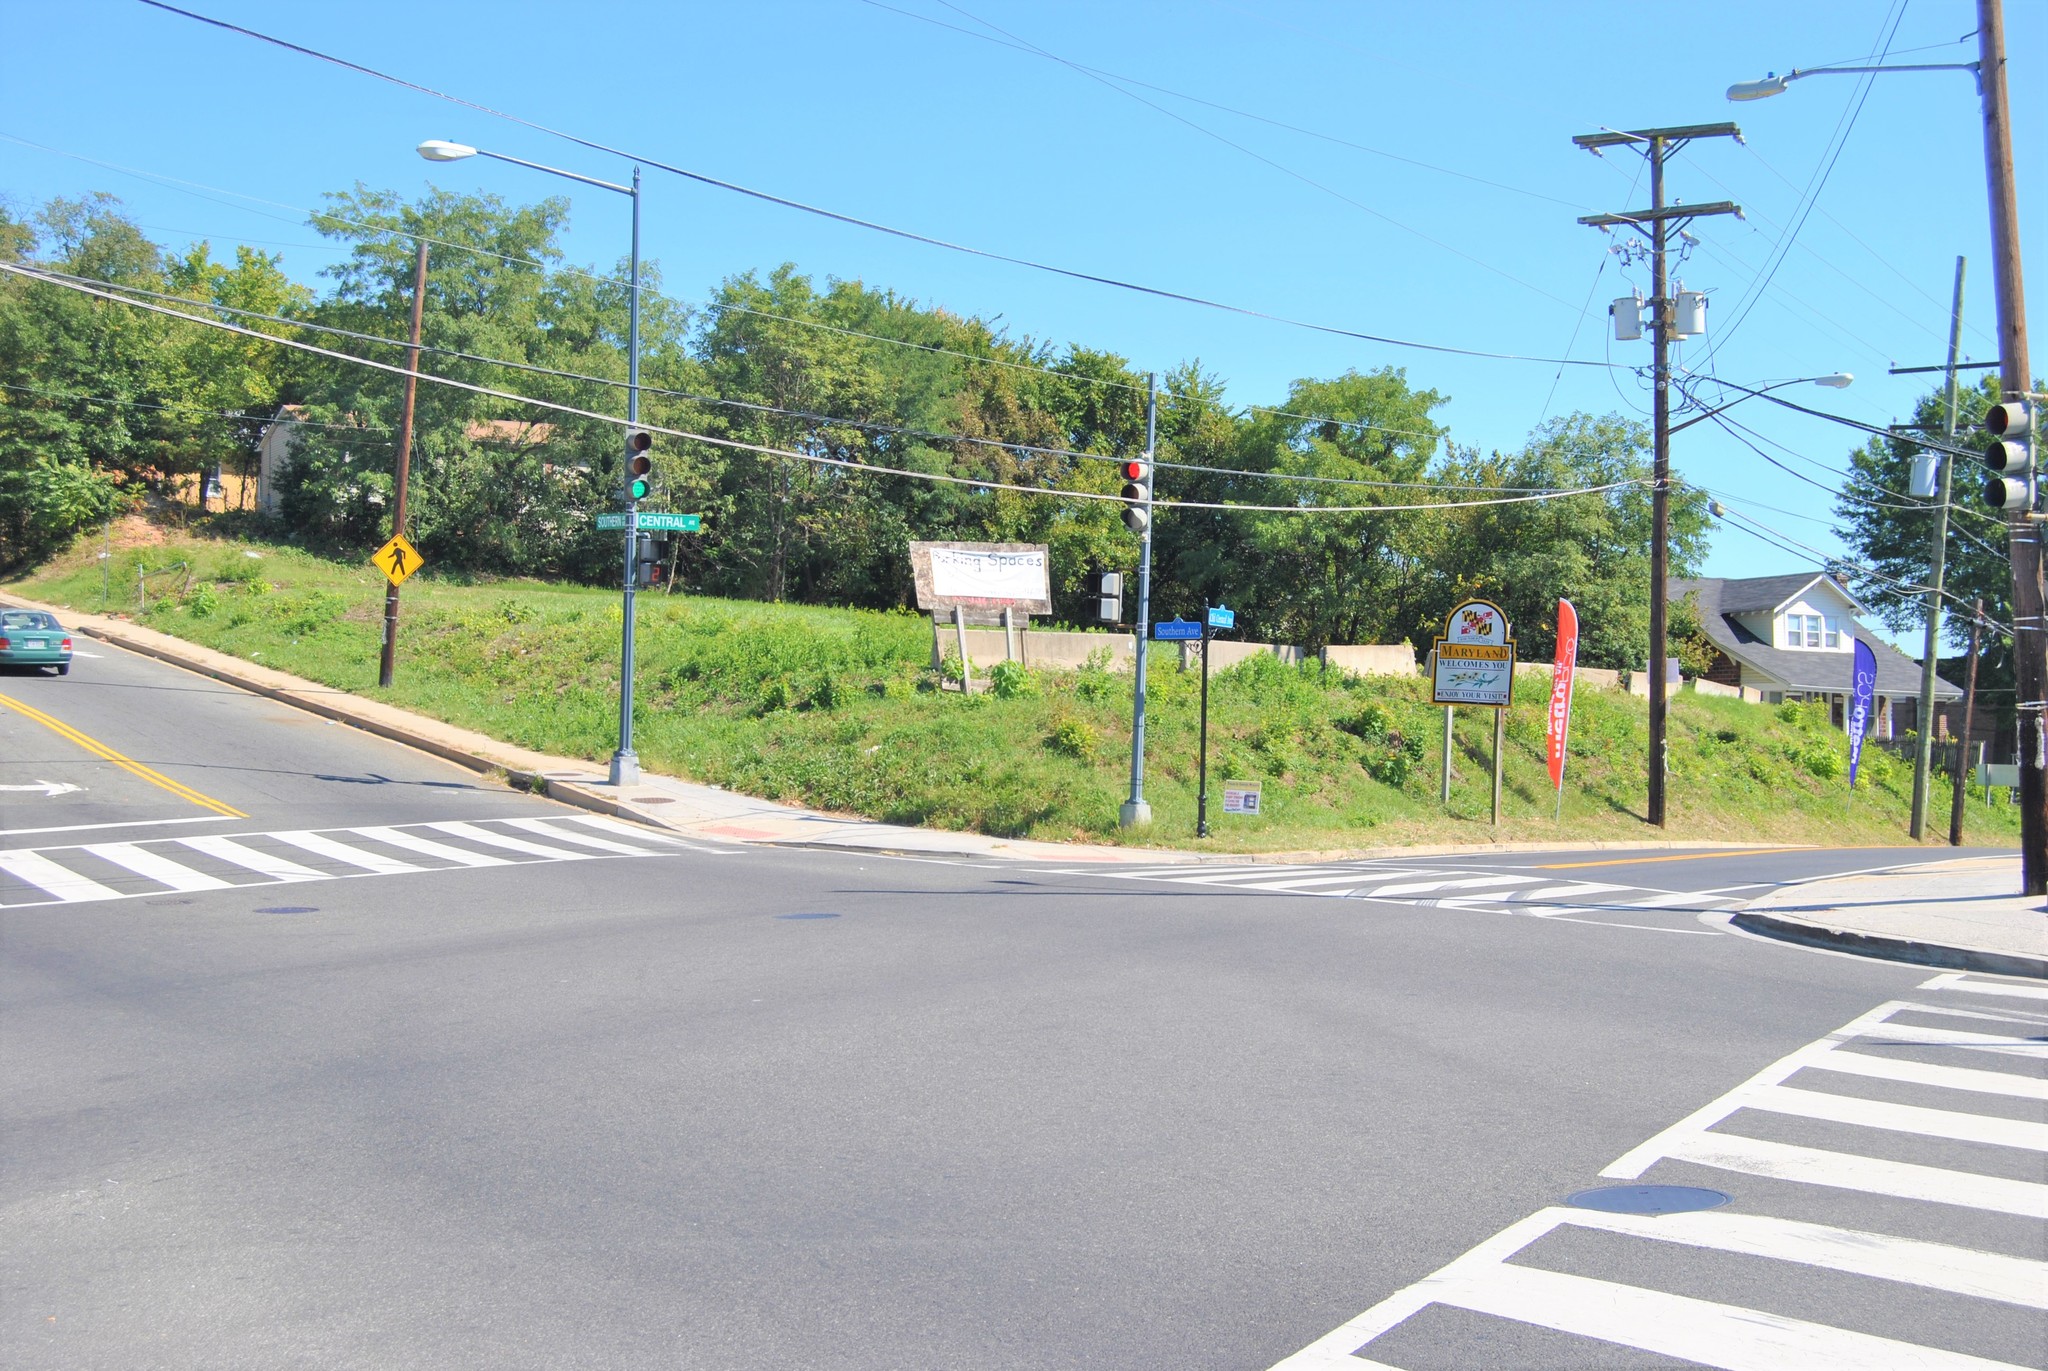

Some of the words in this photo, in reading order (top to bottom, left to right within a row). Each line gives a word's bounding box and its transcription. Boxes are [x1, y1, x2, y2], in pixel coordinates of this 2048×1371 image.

[597, 516, 622, 528] SOUTHERN
[639, 515, 686, 528] CENTRAL
[988, 553, 1042, 573] Spaces
[652, 567, 660, 582] 2
[1157, 626, 1185, 636] Southern
[1187, 627, 1199, 636] Ave
[1441, 646, 1508, 659] MARYLAND
[1439, 660, 1490, 668] WELCOMES
